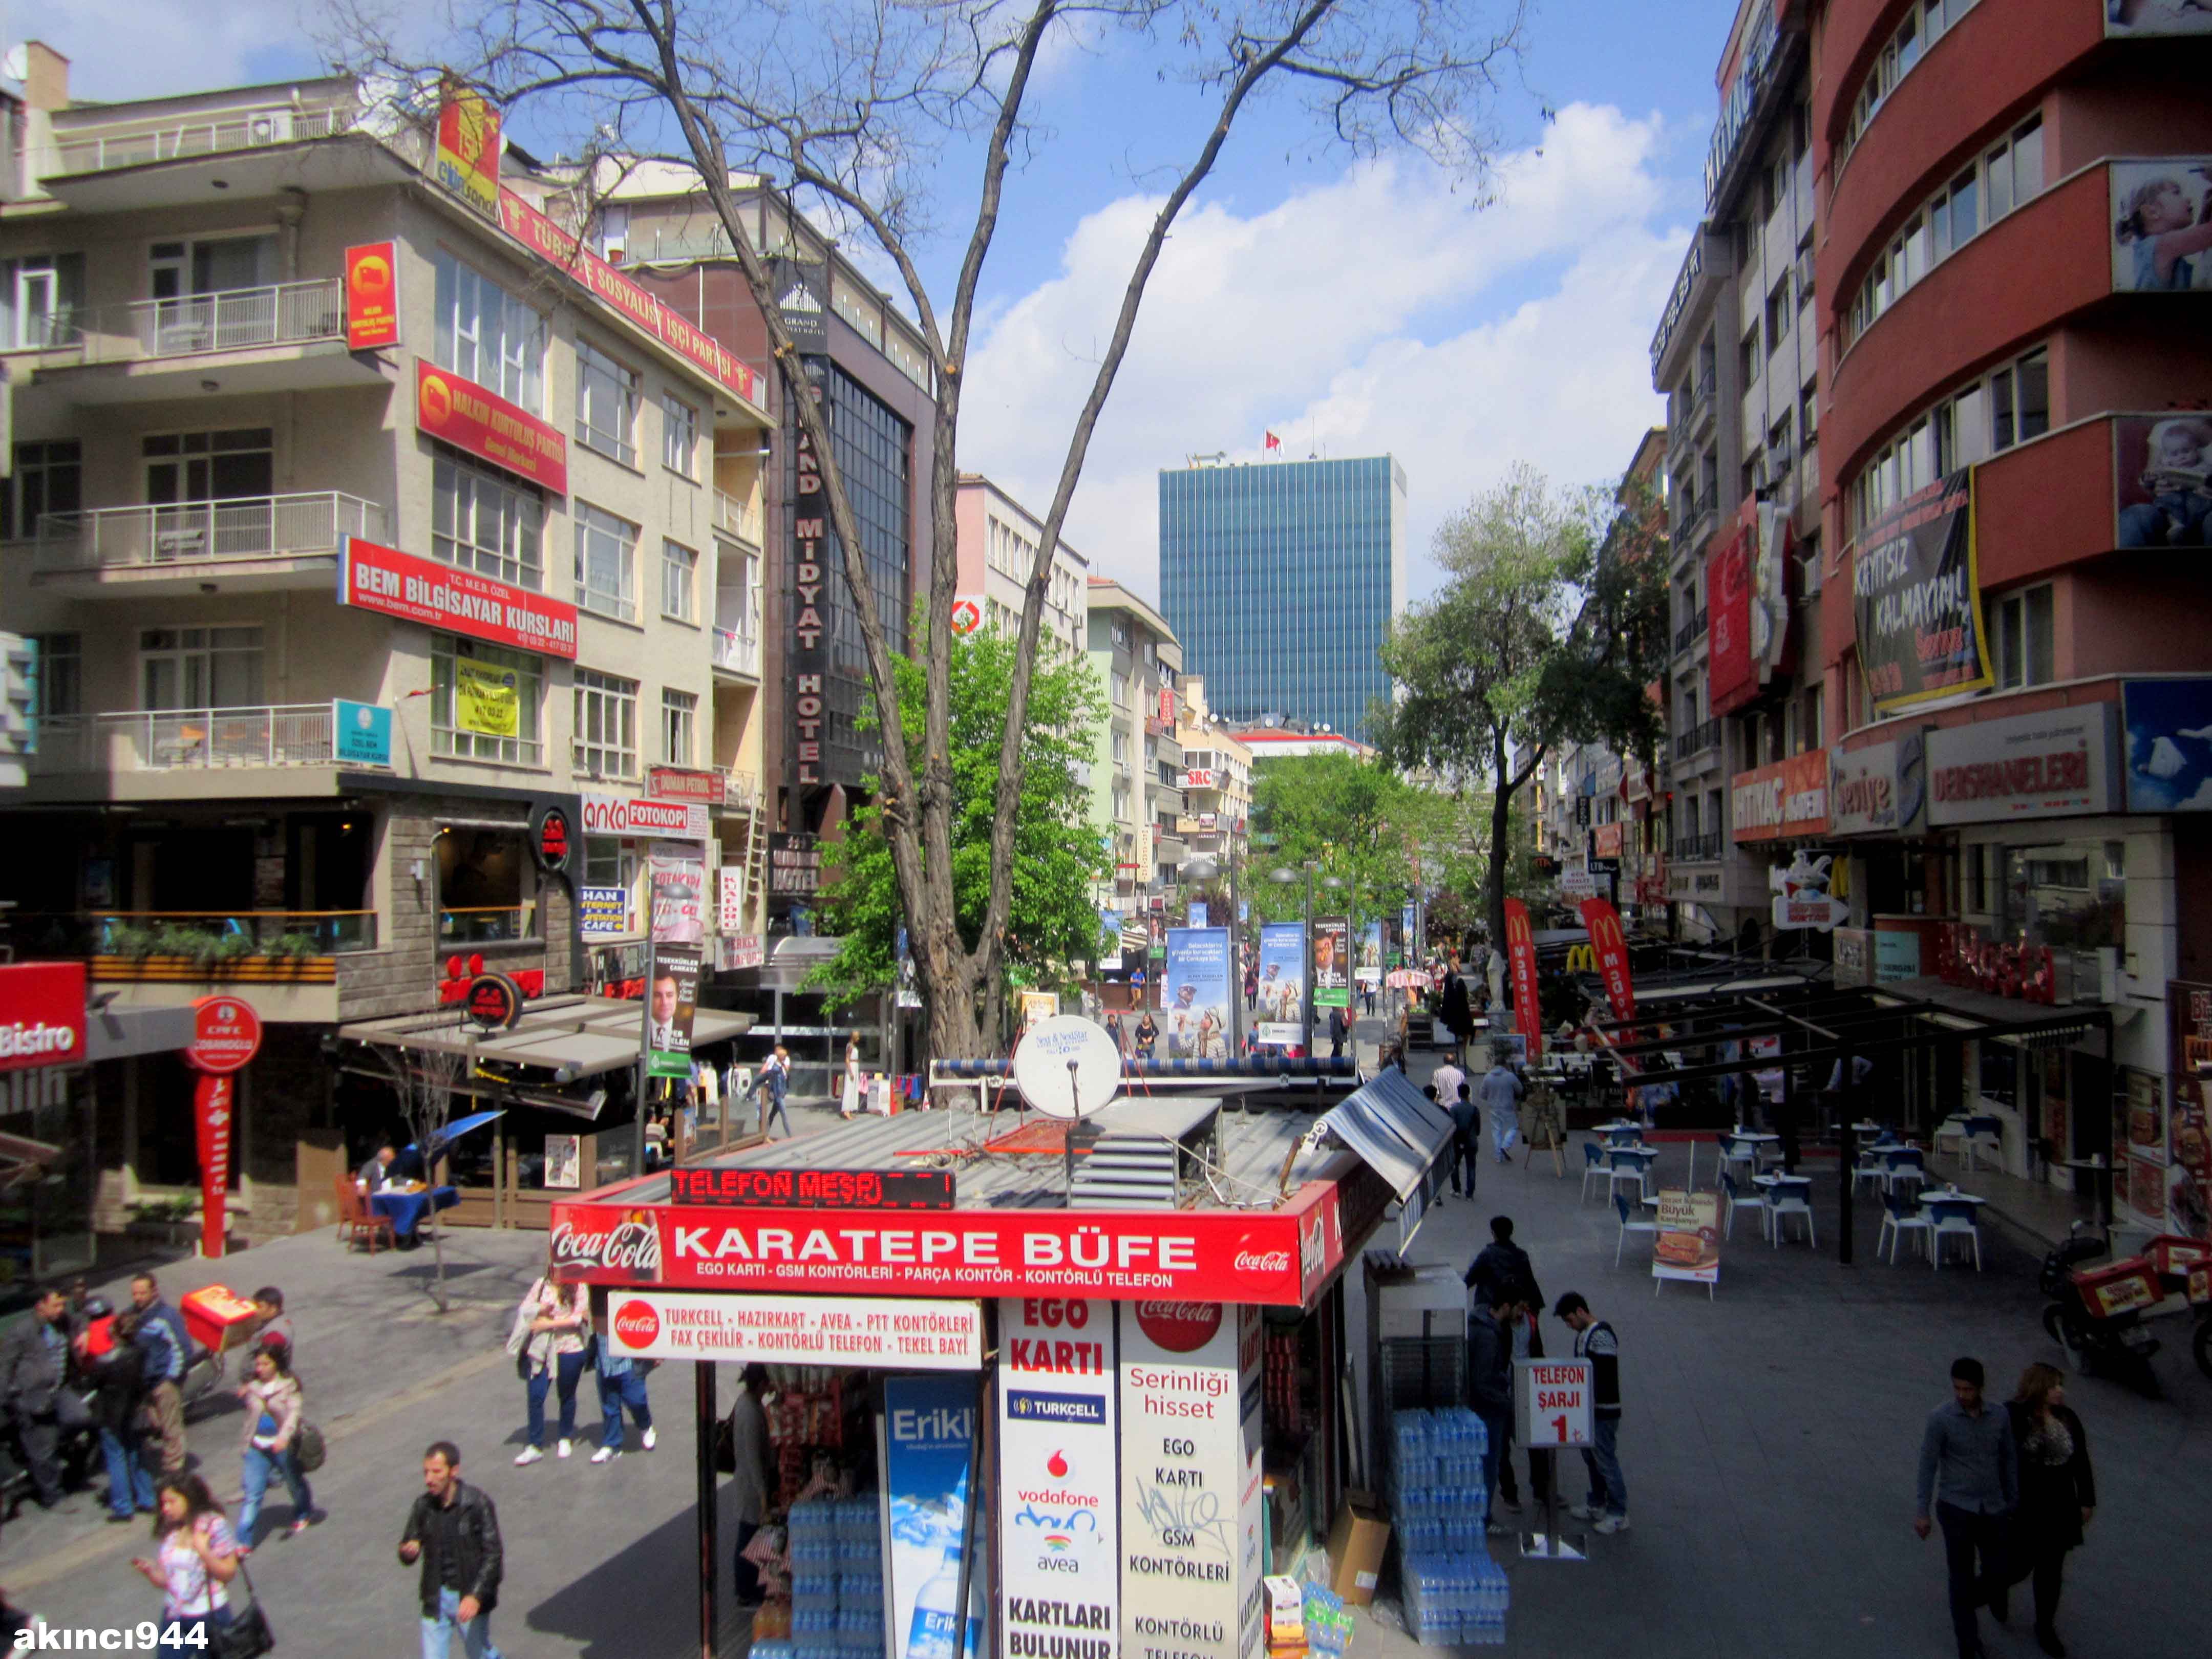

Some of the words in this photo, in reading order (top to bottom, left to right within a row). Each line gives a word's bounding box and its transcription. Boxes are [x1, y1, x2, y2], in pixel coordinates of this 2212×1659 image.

[598, 266, 662, 325] SOSYALİST
[667, 312, 690, 350] İŞÇİ
[784, 317, 818, 327] GRAND
[355, 562, 399, 598] BEM
[406, 575, 502, 626] BİLGİSAYAR
[506, 606, 574, 643] KURSLARI
[797, 673, 822, 784] HOTEL
[1188, 770, 1211, 786] SRC
[1933, 737, 2089, 802] DERSHANELERİ
[630, 805, 687, 826] FOTOKOPİ
[583, 890, 617, 901] HAN
[584, 921, 613, 930] CAFE
[0, 1022, 74, 1056] Bistro
[672, 1171, 792, 1197] TELEFON
[551, 1220, 661, 1270] Coca-Cola
[675, 1226, 999, 1266] KARATEPE
[1023, 1225, 1197, 1270] BÜFE
[1234, 1250, 1288, 1271] Coca-Cola
[697, 1263, 724, 1275] EGO
[727, 1263, 765, 1277] KARTI
[776, 1264, 804, 1278] GSM
[808, 1262, 894, 1280] KONTÖRLERİ
[904, 1267, 951, 1283] PARÇA
[955, 1265, 1012, 1282] KONTÖR
[1025, 1268, 1102, 1286] KONTÖRLÜ
[1107, 1272, 1172, 1288] TELEFON
[616, 1315, 657, 1332] Coca-Cola
[666, 1307, 723, 1327] TURKCELL
[737, 1309, 806, 1329] HAZIRKART
[820, 1310, 852, 1330] AVEA
[867, 1311, 888, 1331] PTT
[893, 1309, 974, 1333] KONTÖRLERİ
[1024, 1299, 1089, 1329] EGO
[670, 1329, 693, 1347] FAX
[697, 1327, 744, 1352] ÇEKİLİR
[758, 1330, 825, 1350] KONTÖRLÜ
[828, 1334, 883, 1353] TELEFON
[897, 1336, 935, 1355] TEKEL
[938, 1335, 969, 1356] BAYİ
[1010, 1338, 1103, 1376] KARTI
[1130, 1368, 1229, 1398] Serinliği
[1533, 1367, 1585, 1386] TELEFON
[1034, 1401, 1099, 1418] TURKCELL
[1143, 1395, 1215, 1419] hisset
[1538, 1392, 1581, 1412] ŞARJI
[893, 1408, 975, 1441] Erikl
[1551, 1414, 1567, 1443] 1
[1163, 1438, 1195, 1455] EGO
[1155, 1467, 1203, 1487] KARTI
[1018, 1489, 1099, 1508] vodafone
[1162, 1528, 1196, 1547] GSM
[1037, 1556, 1079, 1573] avea
[1129, 1555, 1230, 1582] KONTÖRLERİ
[1009, 1597, 1111, 1630] KARTLARI
[1135, 1616, 1224, 1642] KONTÖRLÜ
[1009, 1632, 1111, 1659] BULUNUR
